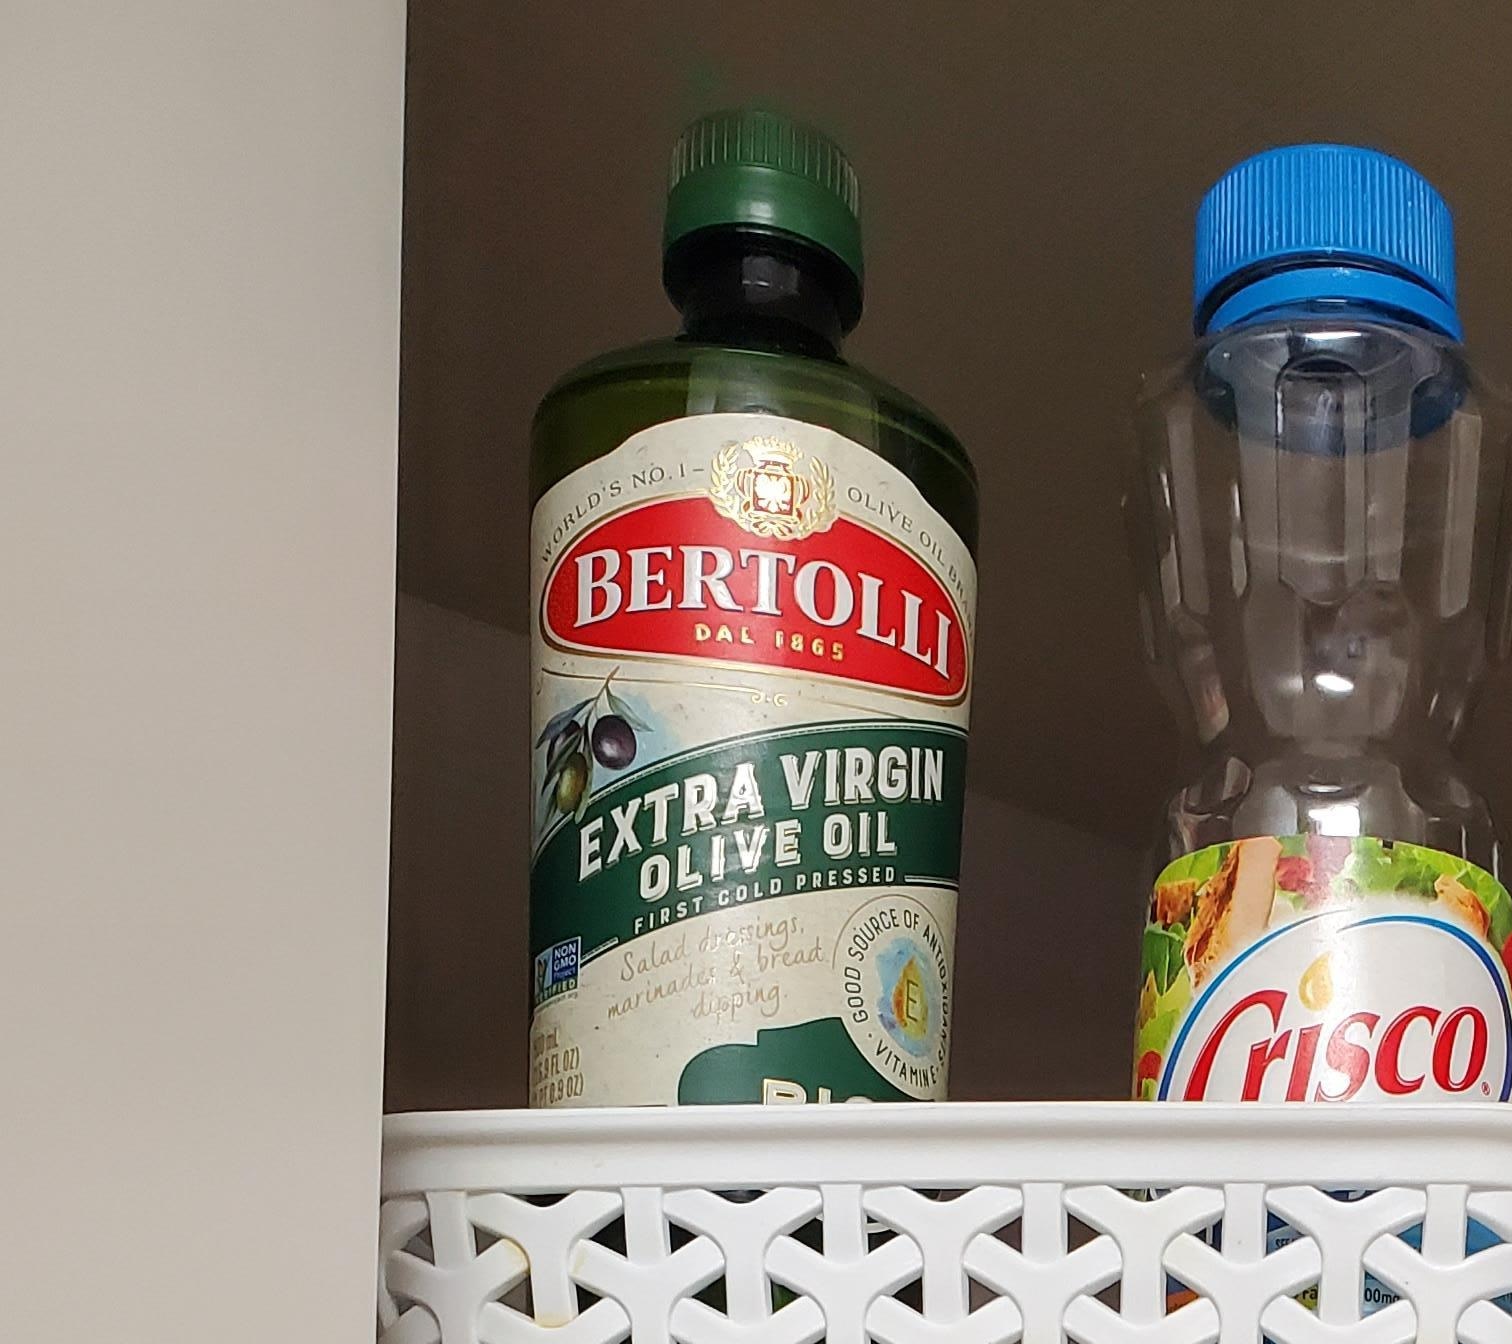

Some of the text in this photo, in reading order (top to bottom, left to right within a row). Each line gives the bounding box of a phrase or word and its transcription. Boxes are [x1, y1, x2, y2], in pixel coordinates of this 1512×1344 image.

[541, 480, 622, 563] WORLD'S
[847, 486, 913, 533] OLIVE
[918, 530, 946, 567] OIL
[573, 545, 952, 680] BERTOLLI
[694, 623, 845, 662] DAL 1865
[577, 746, 944, 883] EXTRA VIRGIN
[639, 810, 898, 902] OLIVE OIL
[633, 866, 896, 935] FIRST COLD PRESSED
[903, 909, 919, 931] OF
[553, 942, 577, 960] NON
[621, 934, 686, 982] Salad
[848, 909, 899, 961] SOURCE
[553, 955, 577, 971] GMO
[607, 965, 717, 1020] marinades
[730, 950, 745, 984] &
[757, 936, 824, 973] bread
[844, 966, 868, 1023] GOOD
[905, 979, 919, 1023] E
[876, 1039, 930, 1088] VITAMIN
